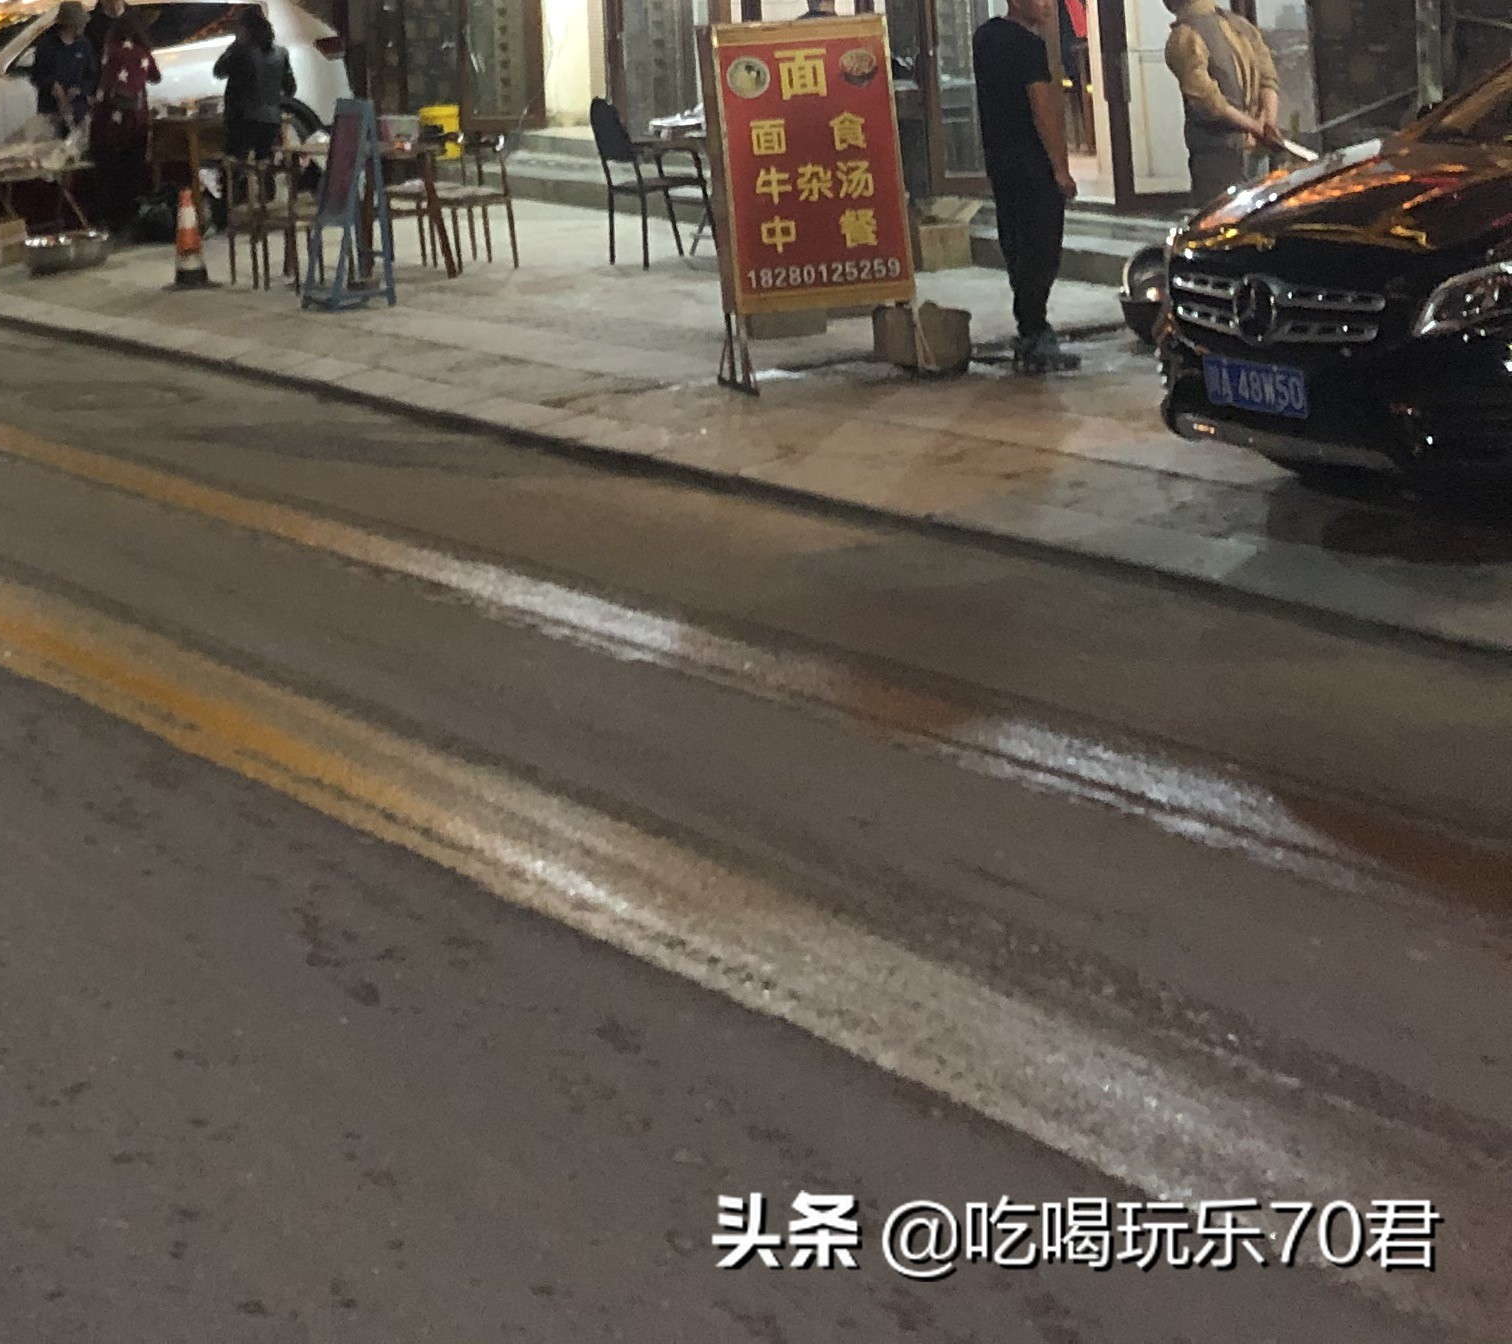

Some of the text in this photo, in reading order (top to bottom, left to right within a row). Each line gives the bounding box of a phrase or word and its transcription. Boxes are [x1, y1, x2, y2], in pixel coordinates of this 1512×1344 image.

[774, 48, 827, 100] 面
[756, 161, 874, 205] 牛杂汤
[747, 258, 900, 289] 18280125259
